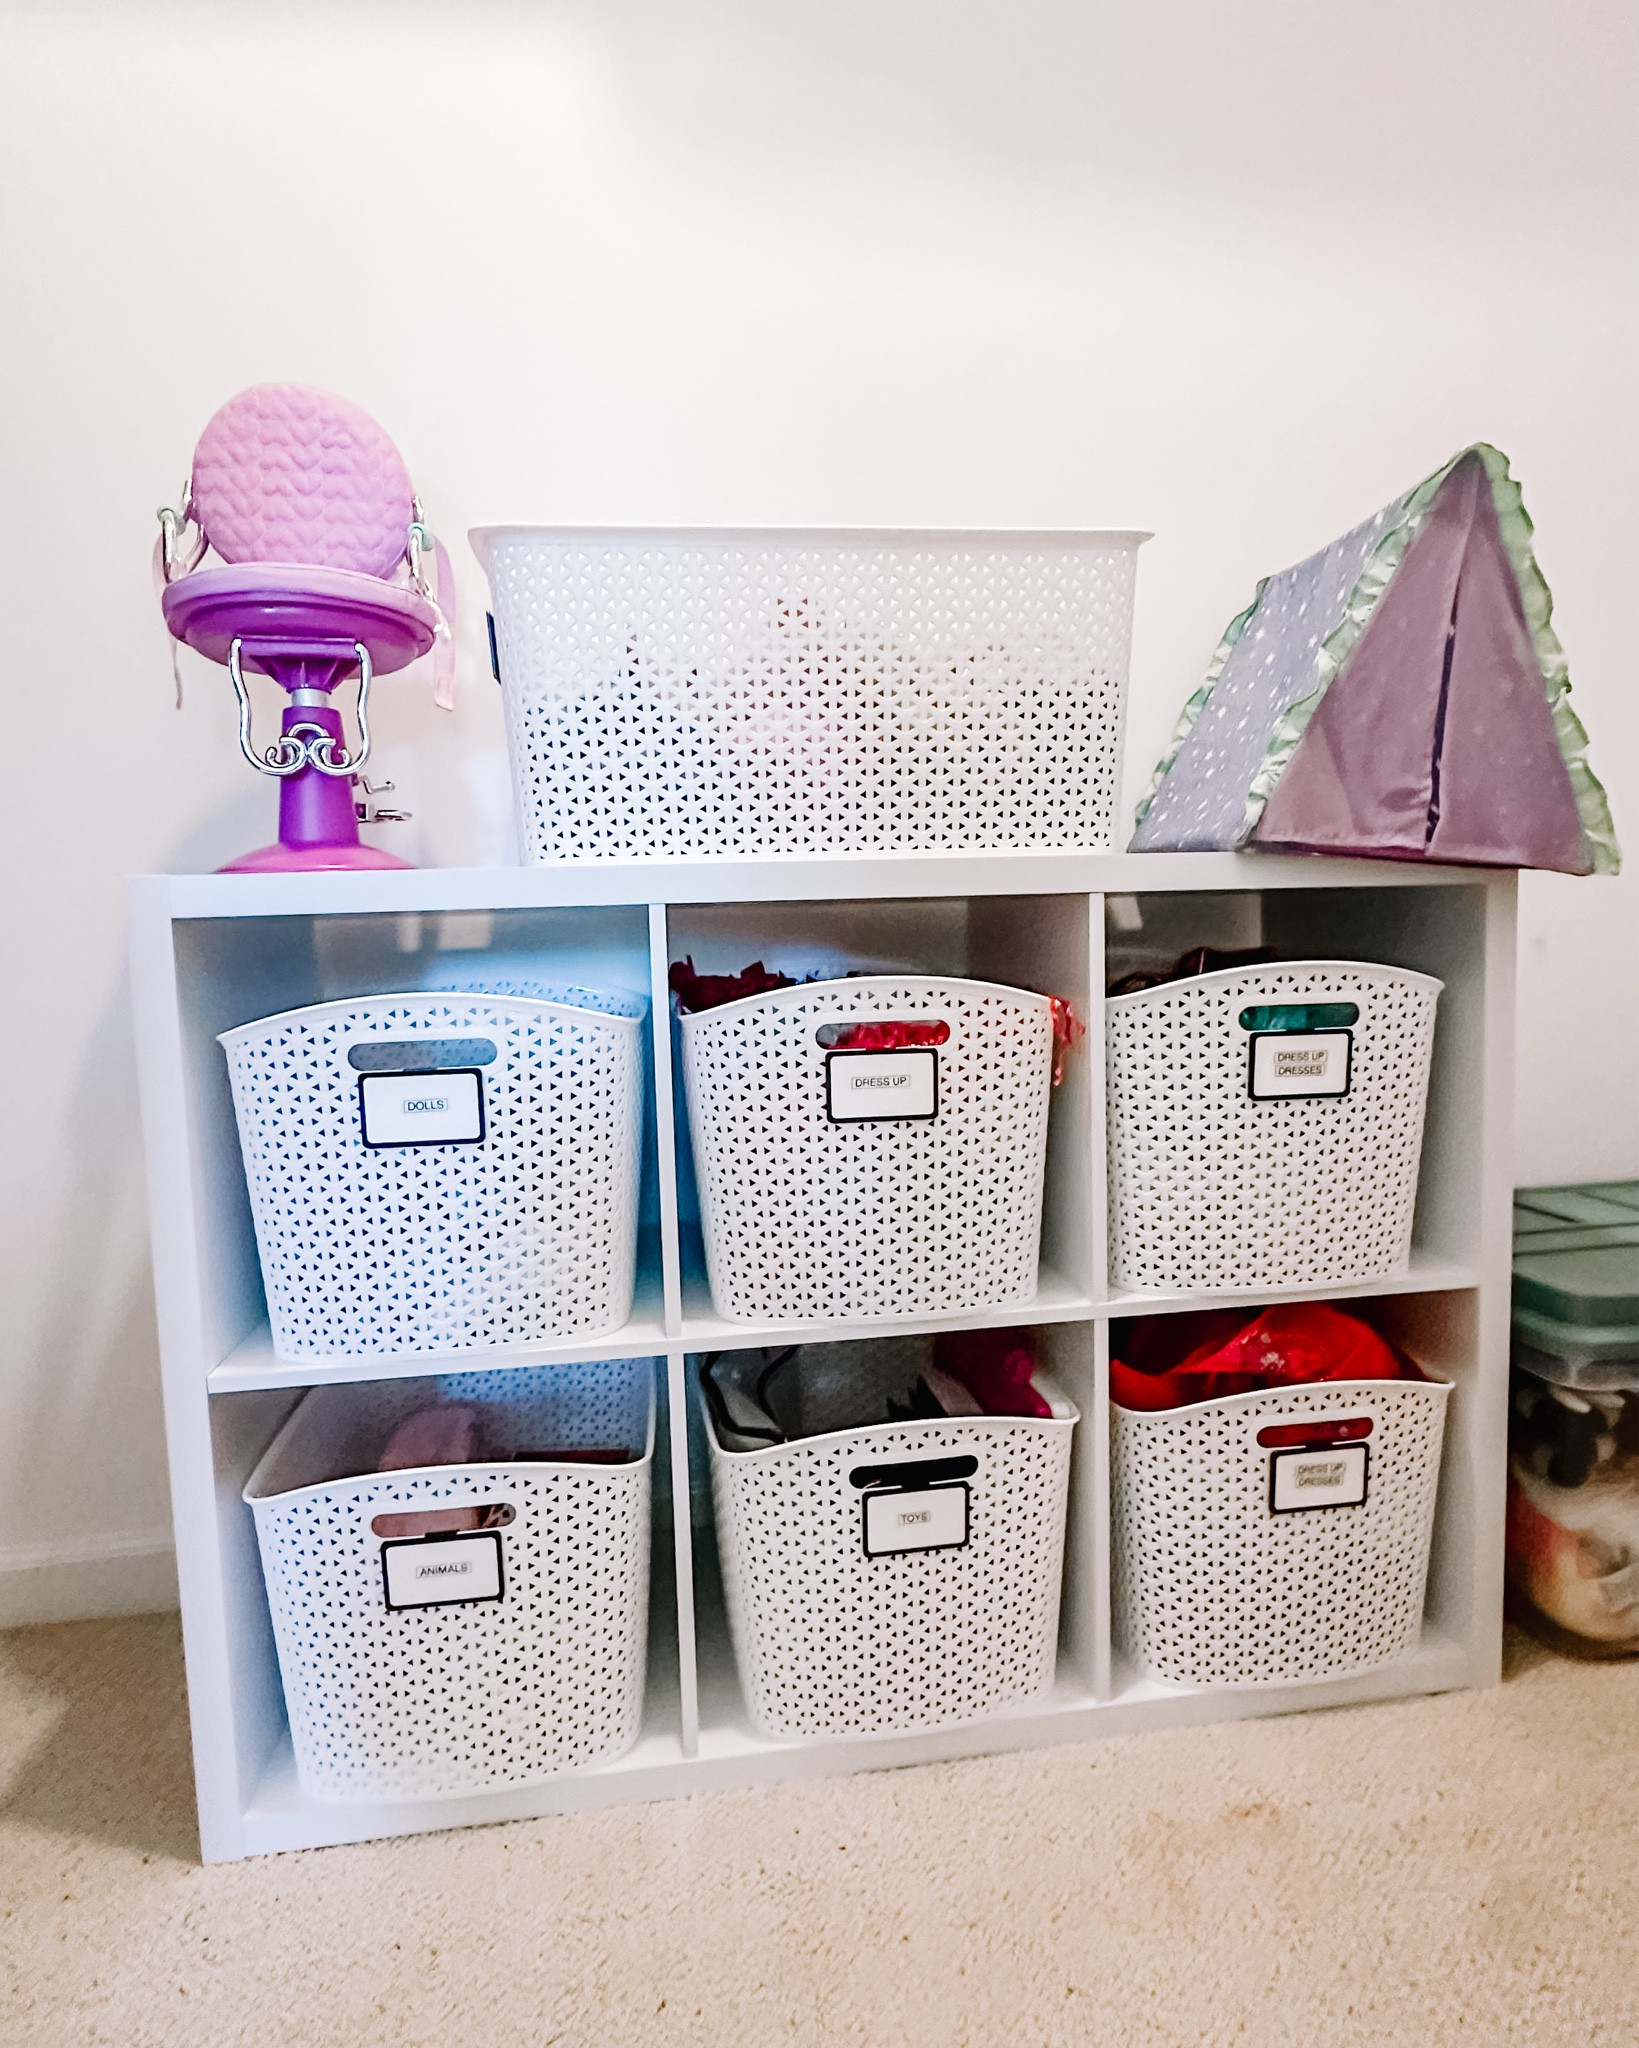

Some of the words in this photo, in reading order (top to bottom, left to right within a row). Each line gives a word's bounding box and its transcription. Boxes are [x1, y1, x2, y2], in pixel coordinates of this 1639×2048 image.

[1277, 1051, 1309, 1062] DRESS
[1311, 1051, 1325, 1061] UP
[1278, 1065, 1322, 1076] DRESSES
[855, 1077, 890, 1088] DRESS
[892, 1076, 907, 1086] UP
[407, 1099, 445, 1111] DOLLS
[900, 1511, 928, 1523] TOYS
[420, 1562, 468, 1577] ANIMALS
